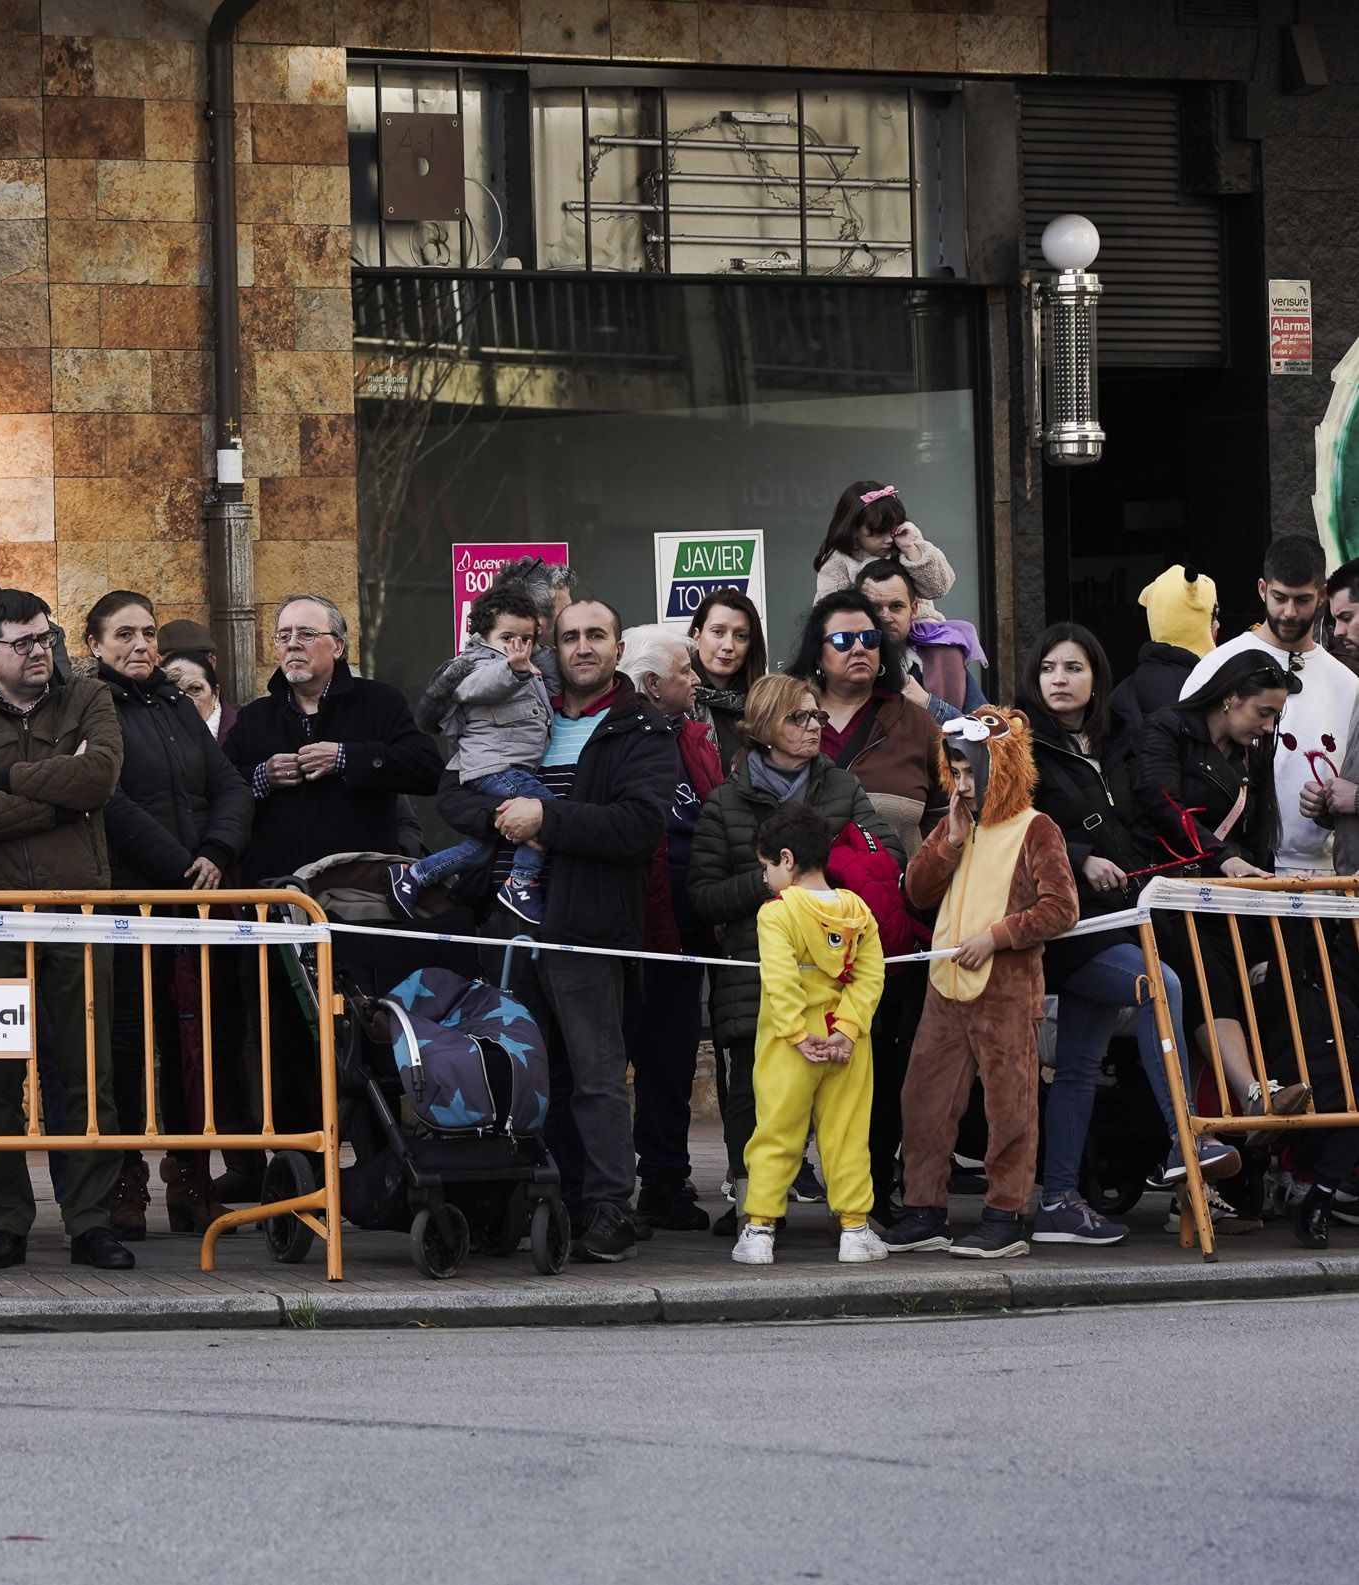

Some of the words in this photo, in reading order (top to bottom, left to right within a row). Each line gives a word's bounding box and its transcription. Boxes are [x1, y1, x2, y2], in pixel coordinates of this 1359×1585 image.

[1272, 298, 1309, 306] verisure
[1273, 318, 1309, 331] Alarma
[385, 374, 409, 384] rápida
[368, 384, 378, 392] de
[682, 545, 744, 573] JAVIER
[401, 882, 412, 895] N
[517, 890, 531, 901] N
